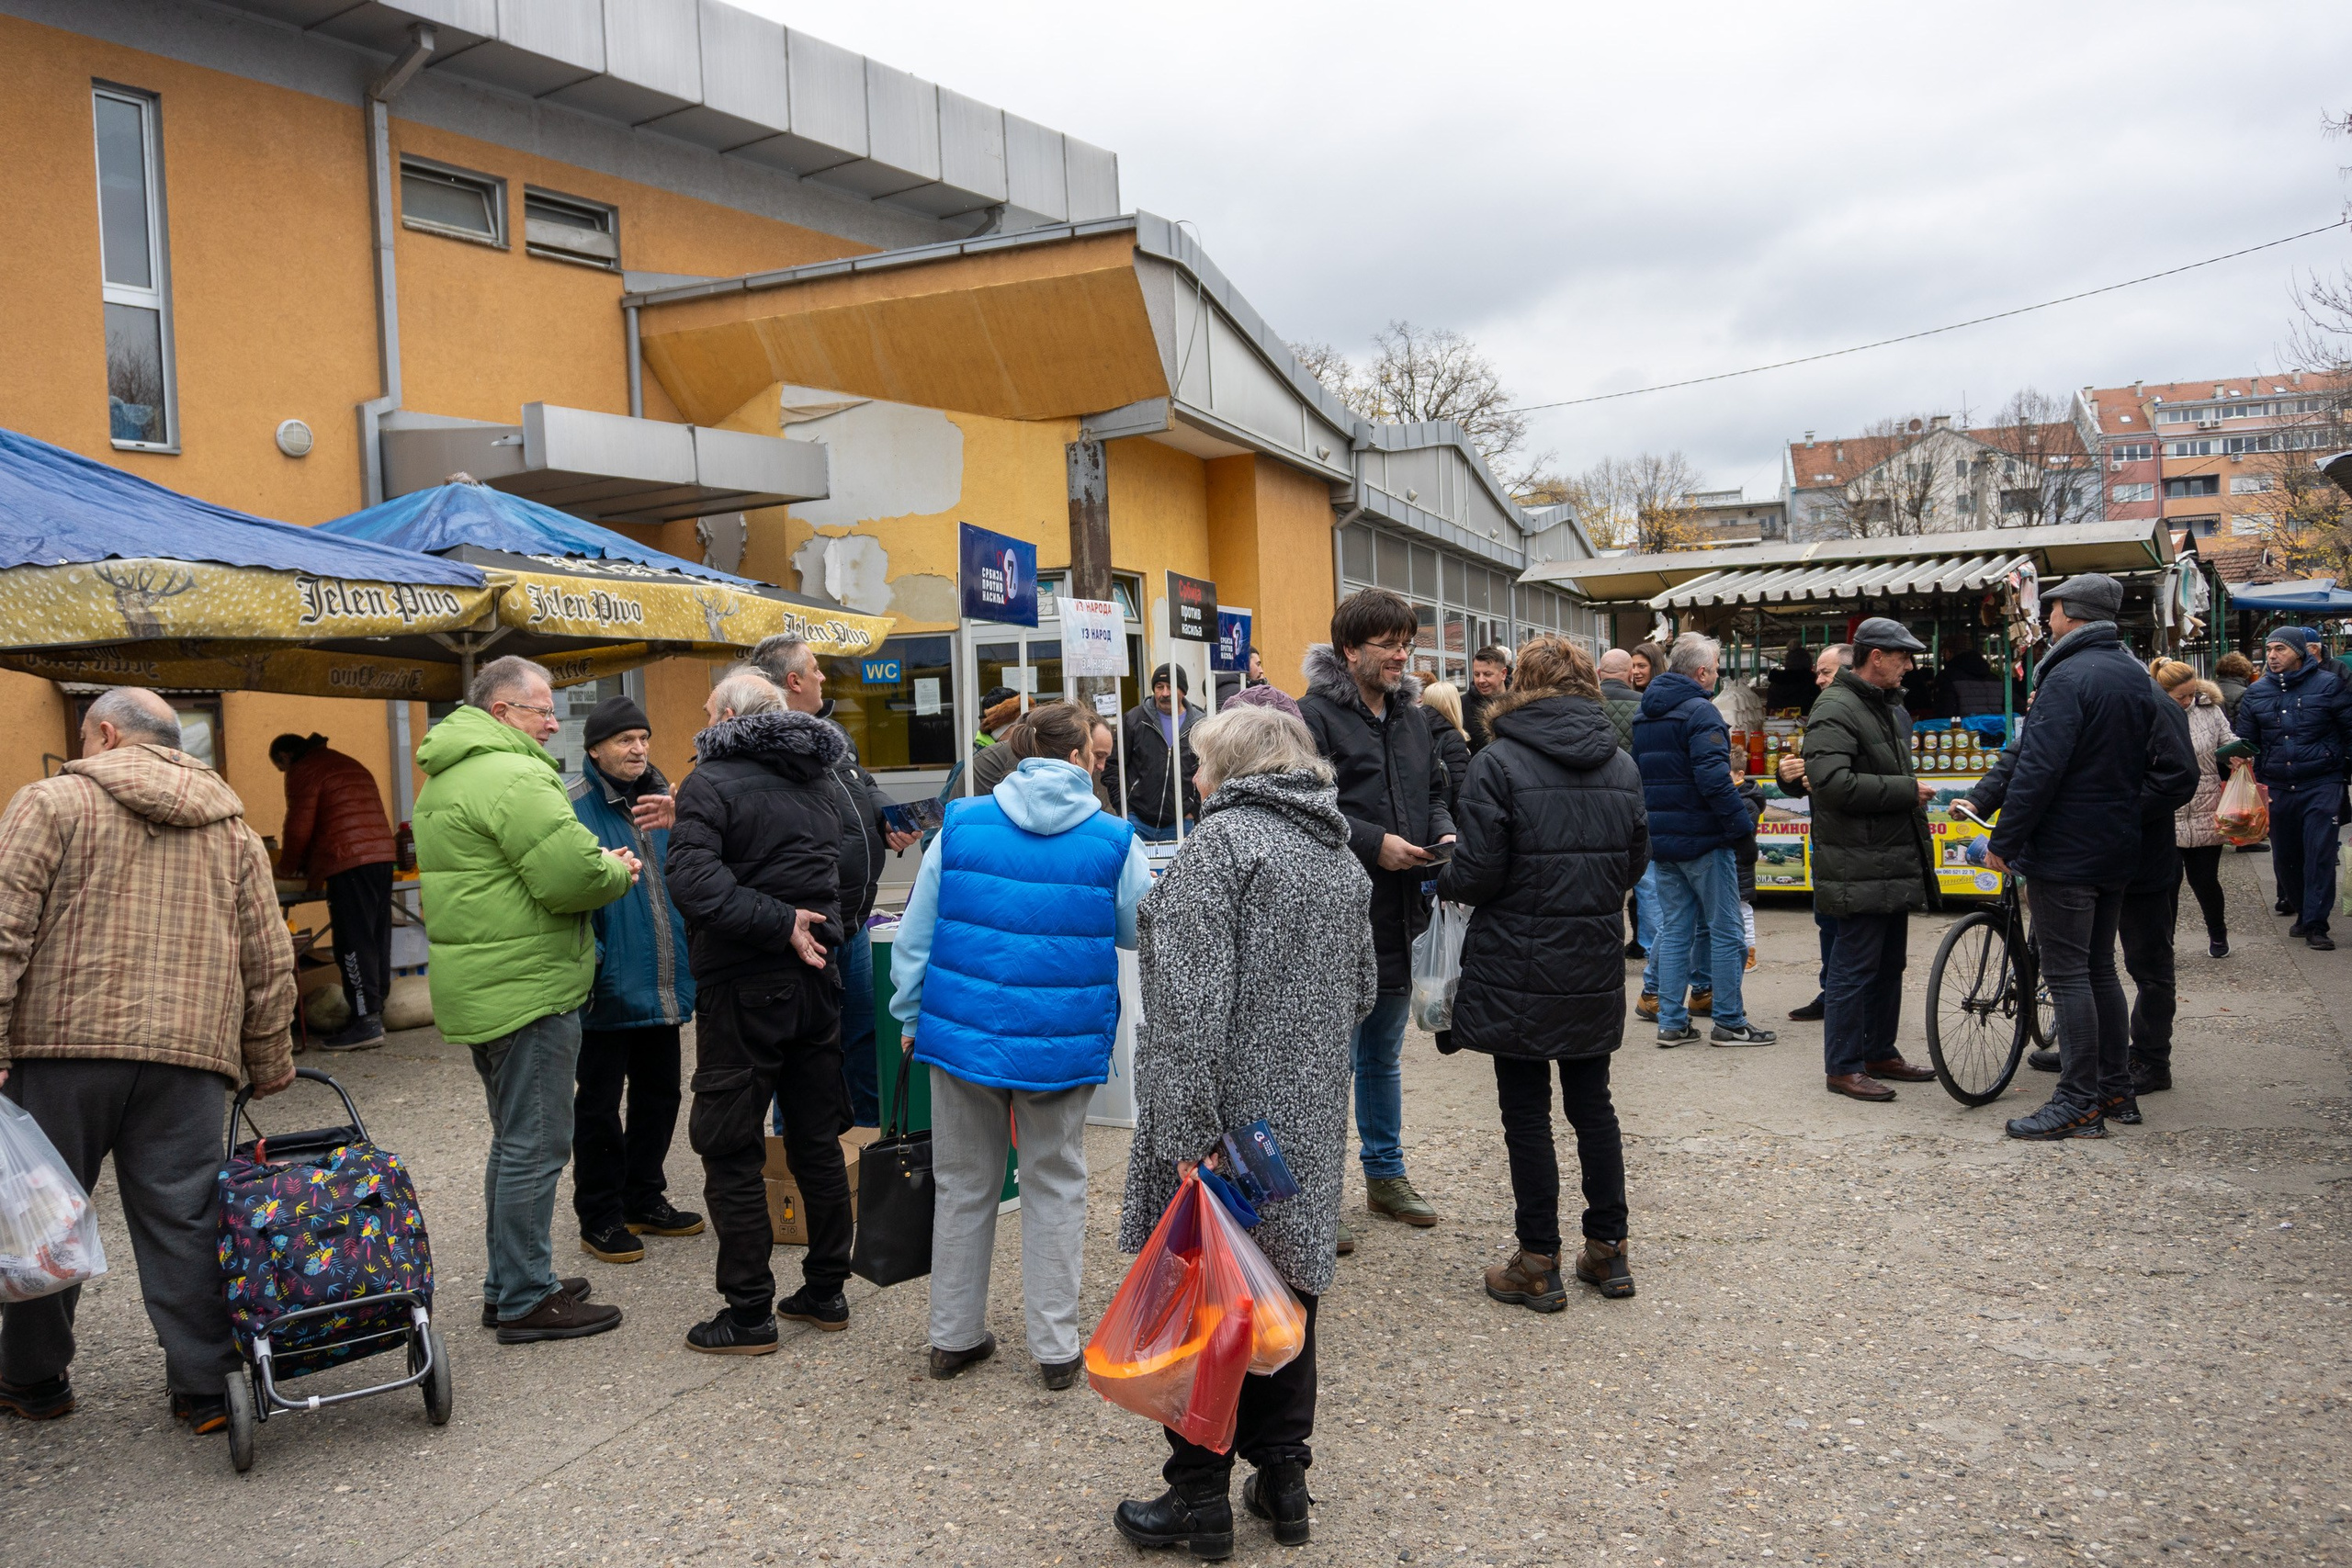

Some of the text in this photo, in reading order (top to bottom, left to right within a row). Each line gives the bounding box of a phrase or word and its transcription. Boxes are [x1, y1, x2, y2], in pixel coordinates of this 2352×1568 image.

[981, 567, 1003, 581] СРБИЈА
[981, 579, 1003, 593] ПРОТИВ
[1179, 580, 1202, 604] Србија
[294, 575, 461, 626] Jelen Pivo
[526, 582, 643, 628] Jelen Pivo
[982, 590, 1005, 604] НАСИЉА
[1085, 601, 1113, 615] НАРОДА
[1181, 605, 1202, 621] против
[826, 621, 871, 648] Pivo
[1080, 627, 1112, 643] УЗ НАРОД
[1182, 623, 1203, 637] насиља
[865, 662, 898, 680] WC
[1081, 658, 1114, 671] ЗА НАРОД
